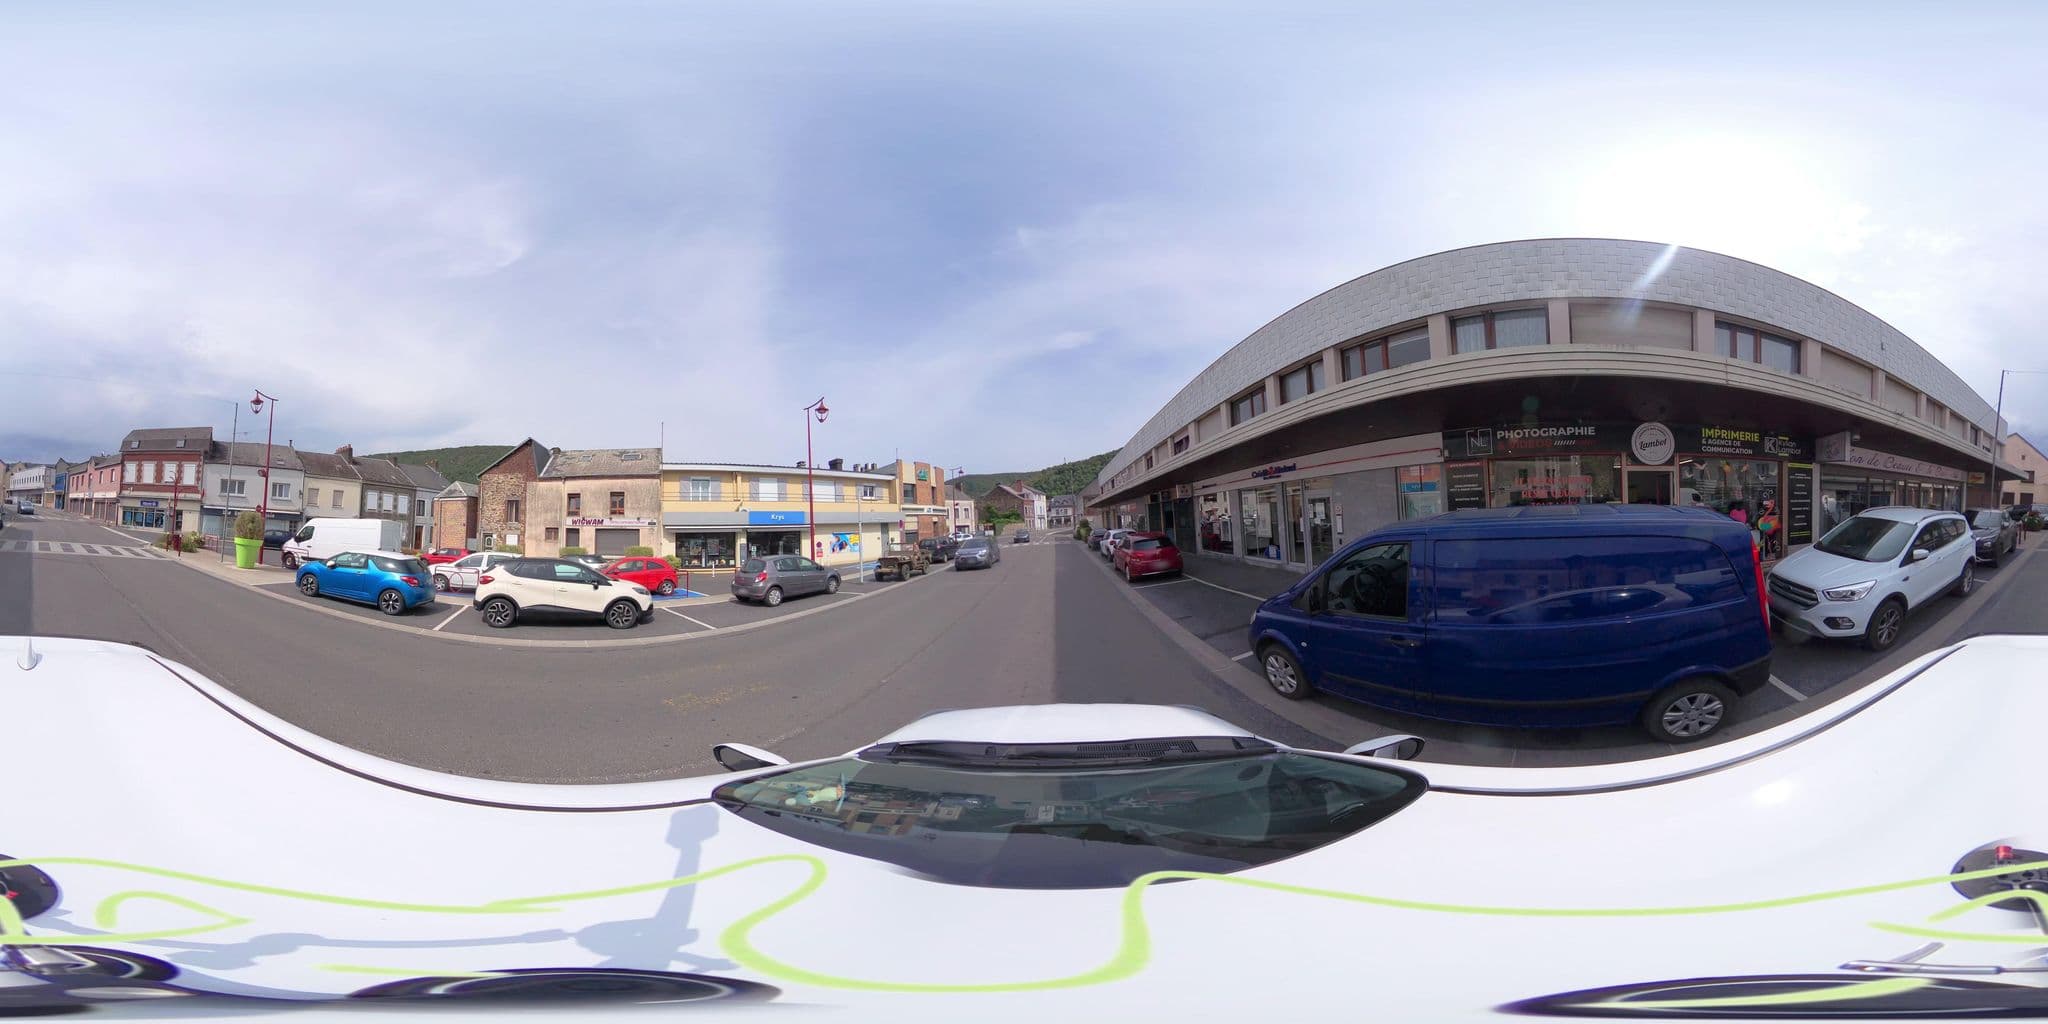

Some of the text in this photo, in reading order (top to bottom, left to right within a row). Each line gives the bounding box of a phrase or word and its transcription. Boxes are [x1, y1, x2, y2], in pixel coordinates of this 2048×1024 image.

[1496, 426, 1596, 440] PHOTOGRAPHIE
[1701, 427, 1760, 442] IMPRIMERIE
[1708, 438, 1732, 446] AGENCE
[1701, 446, 1753, 455] COMMUNICATION
